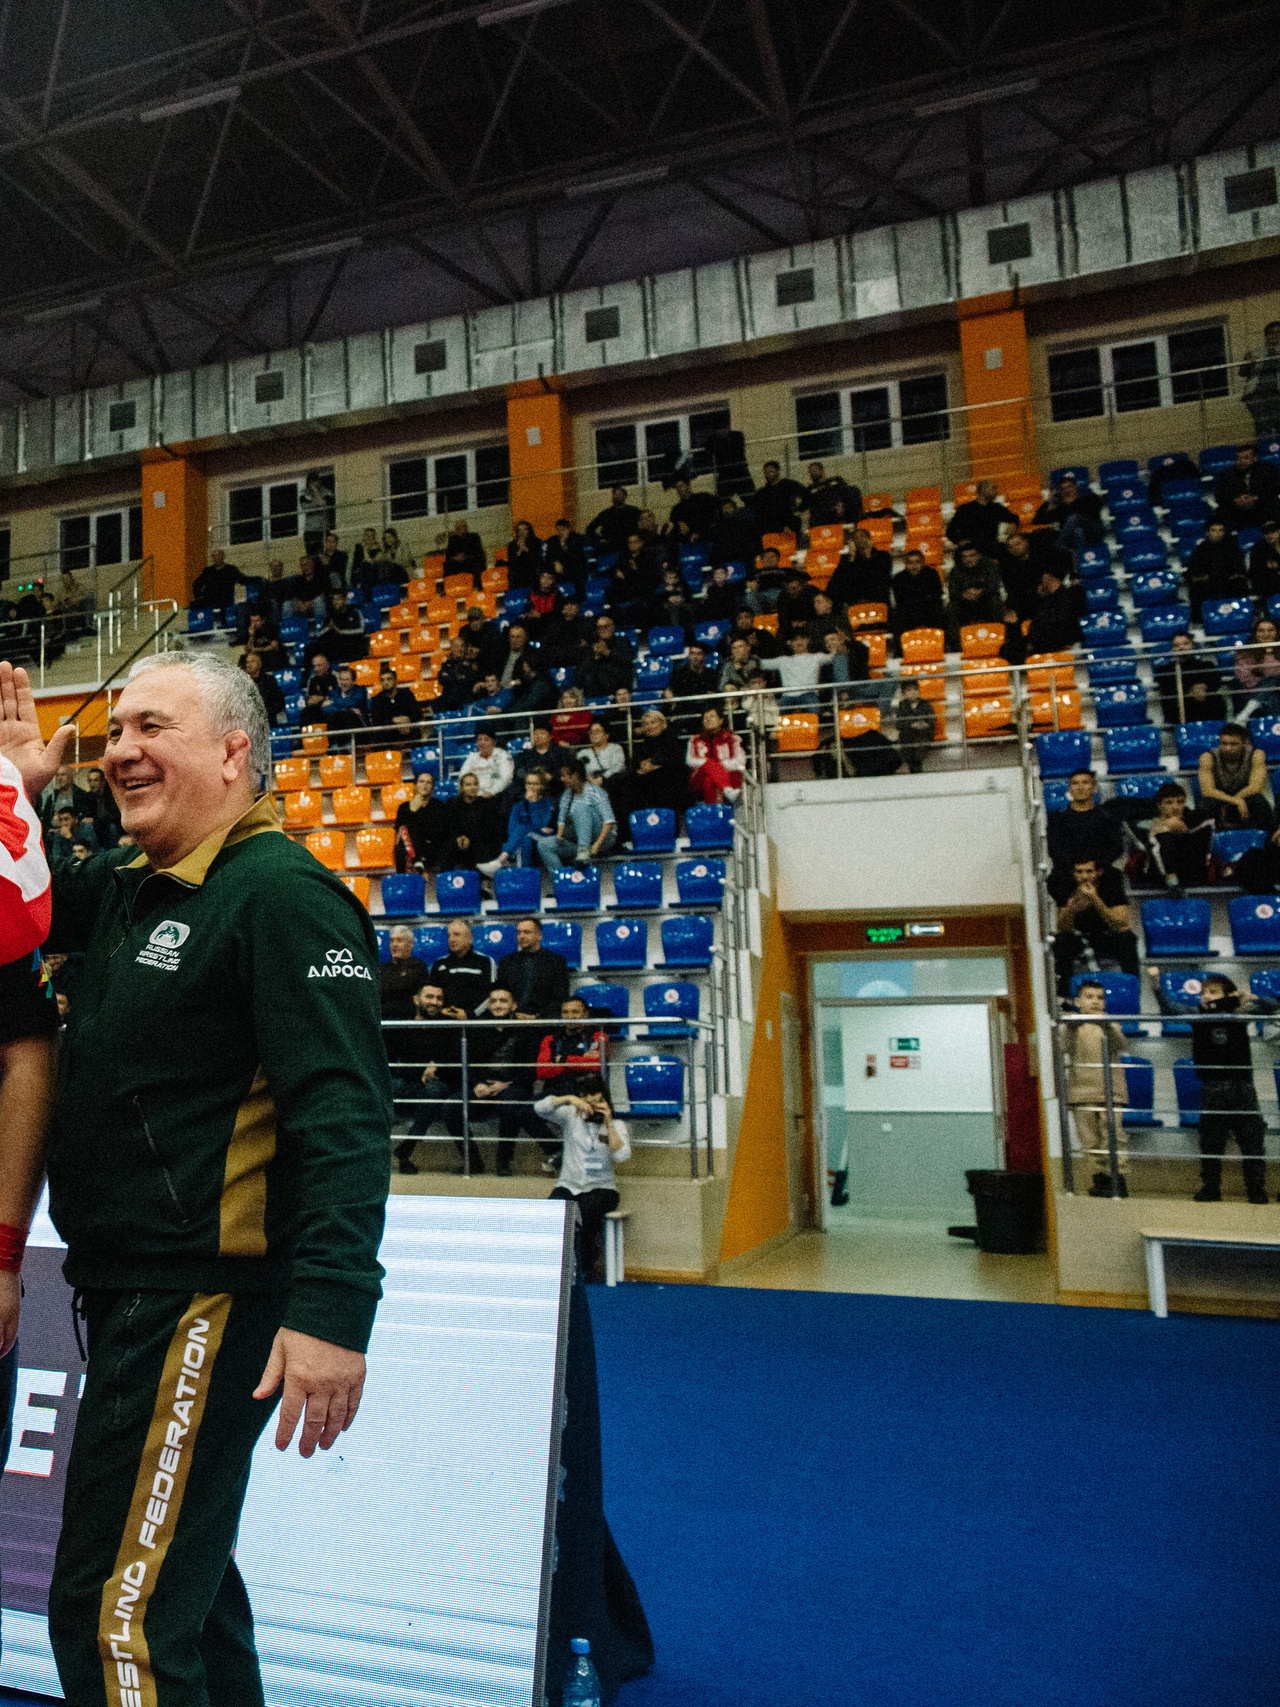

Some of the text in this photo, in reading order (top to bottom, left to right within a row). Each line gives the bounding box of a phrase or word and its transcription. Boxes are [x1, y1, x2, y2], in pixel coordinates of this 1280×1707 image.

[138, 950, 181, 965] WRESTLING
[145, 943, 180, 958] RUSSIAN
[134, 956, 179, 971] FEDERATION
[307, 964, 373, 981] АЛРОСА
[138, 1317, 211, 1550] FEDERATION
